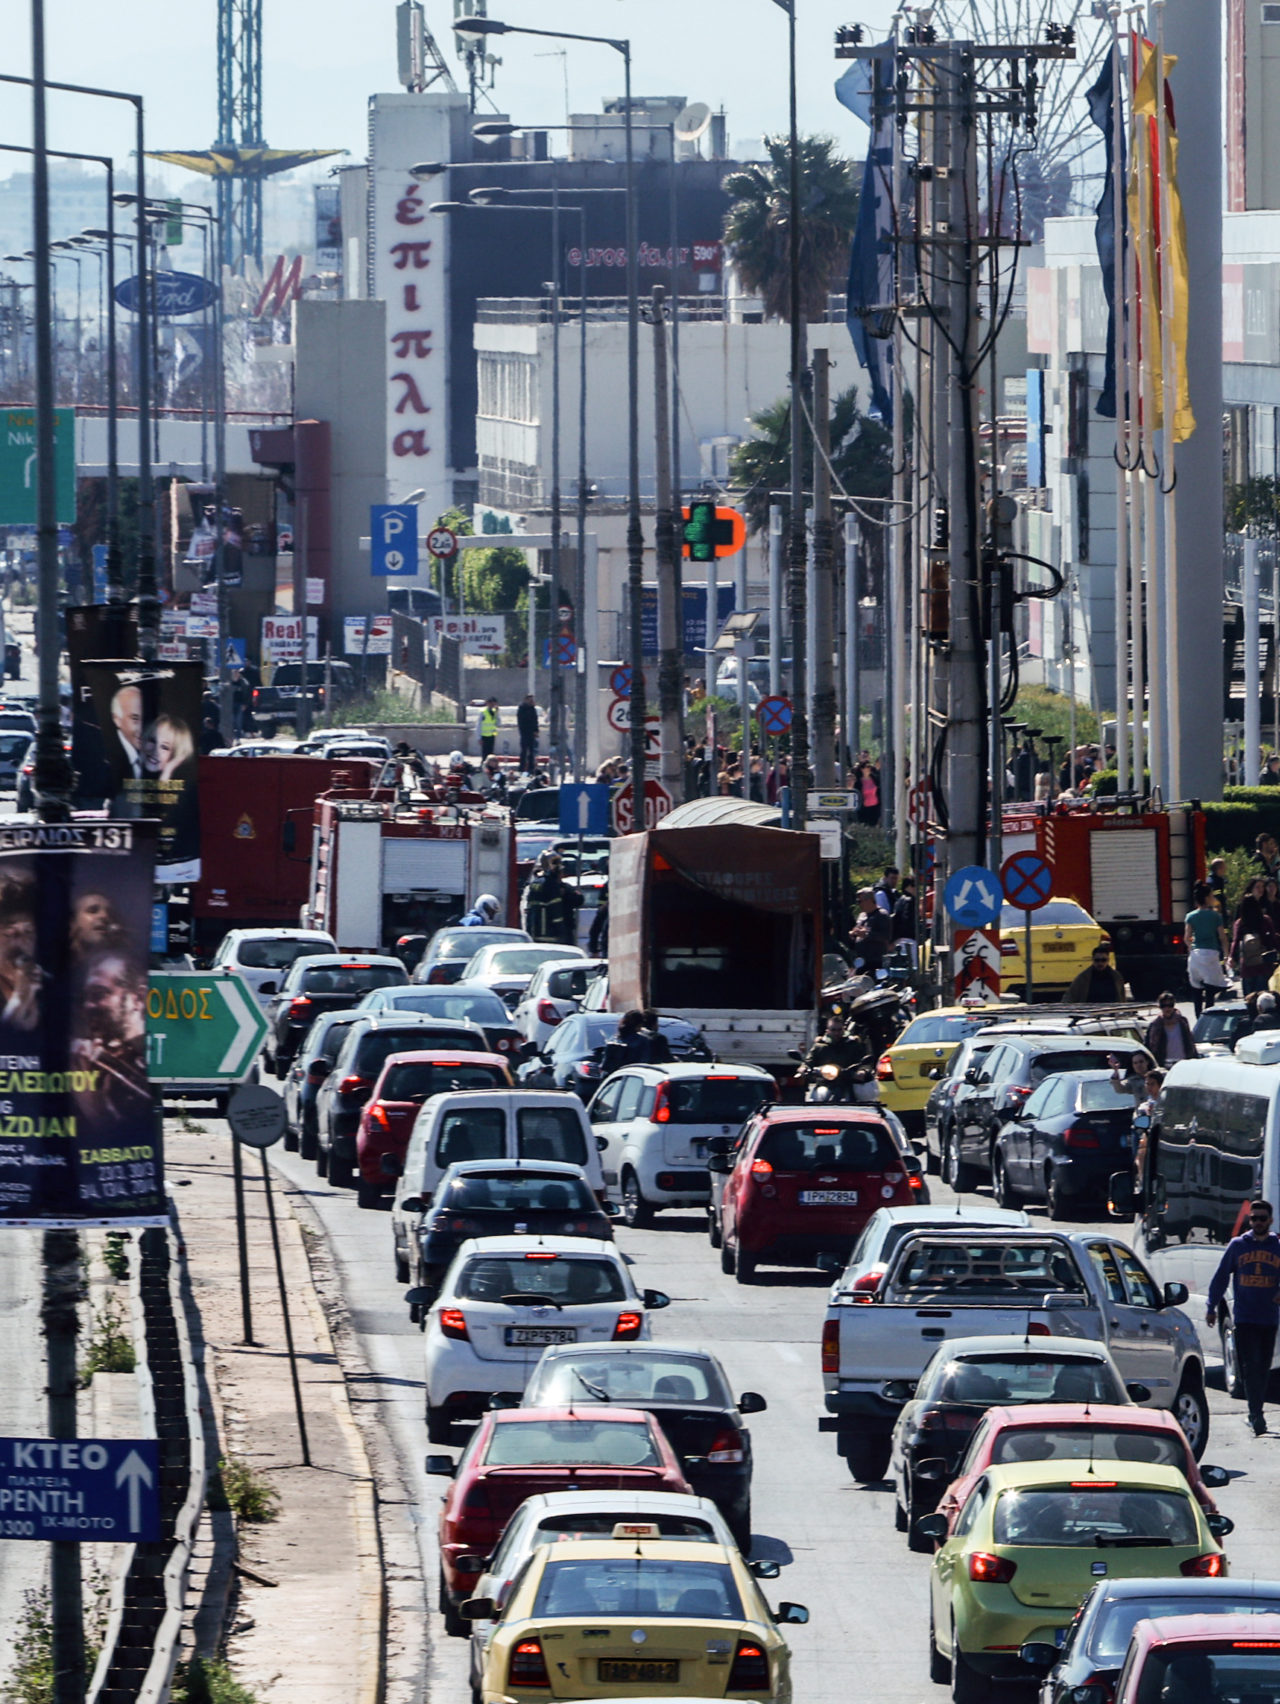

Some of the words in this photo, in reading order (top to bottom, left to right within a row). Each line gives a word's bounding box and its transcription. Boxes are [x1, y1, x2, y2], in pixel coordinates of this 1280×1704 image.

[389, 184, 432, 457] έπιπλα
[618, 796, 667, 831] SOP
[92, 828, 133, 849] 131
[79, 1146, 153, 1165] ΣΑΒΒΑΤΟ
[13, 1442, 109, 1470] ΚΤΕΟ
